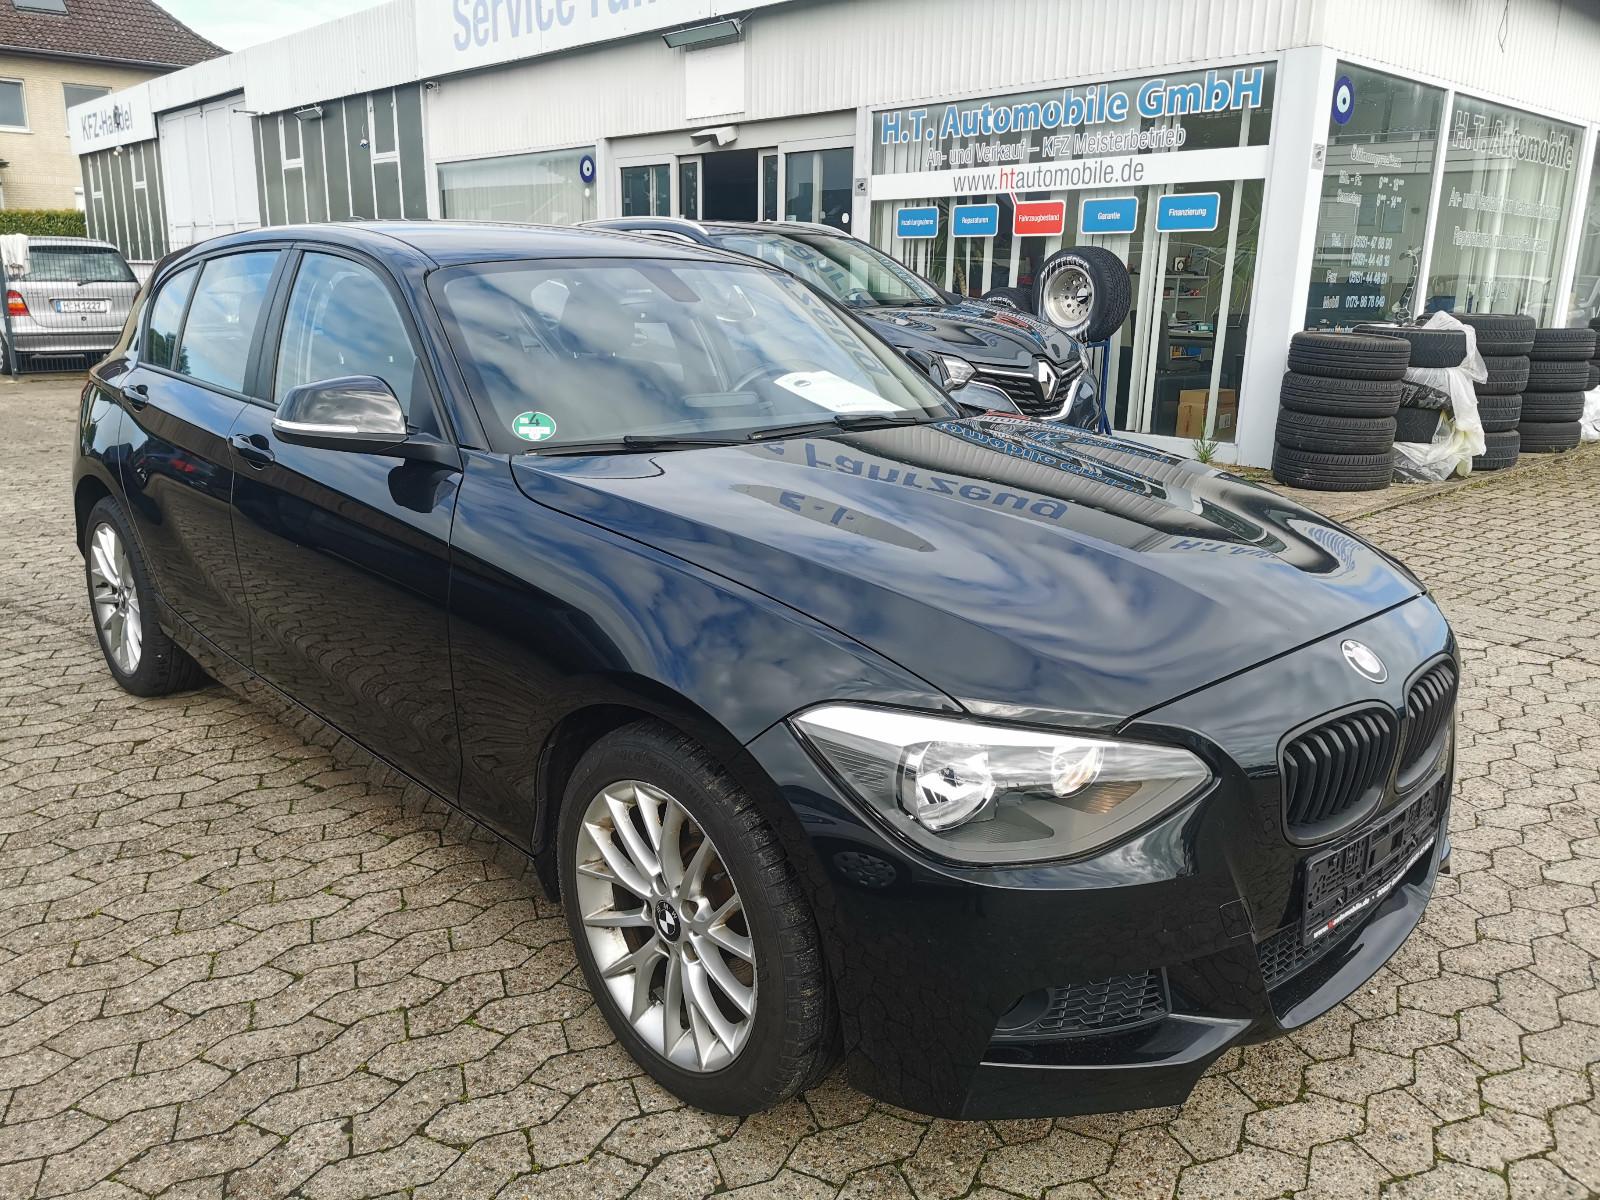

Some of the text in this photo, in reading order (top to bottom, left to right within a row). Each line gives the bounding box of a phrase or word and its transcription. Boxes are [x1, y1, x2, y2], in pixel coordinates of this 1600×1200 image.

[881, 66, 1265, 145] H.T. Automobile GmbH
[925, 147, 947, 167] An-
[949, 143, 972, 164] und
[975, 139, 1025, 163] Verkauf
[1042, 134, 1071, 158] KFZ
[1073, 124, 1186, 155] Meisterbetrieb
[1488, 119, 1573, 170] Automobile
[953, 157, 1144, 192] www.htautomobile.de
[1097, 210, 1121, 220] Garantie
[1168, 207, 1207, 218] Finanzierung
[528, 413, 541, 427] 4
